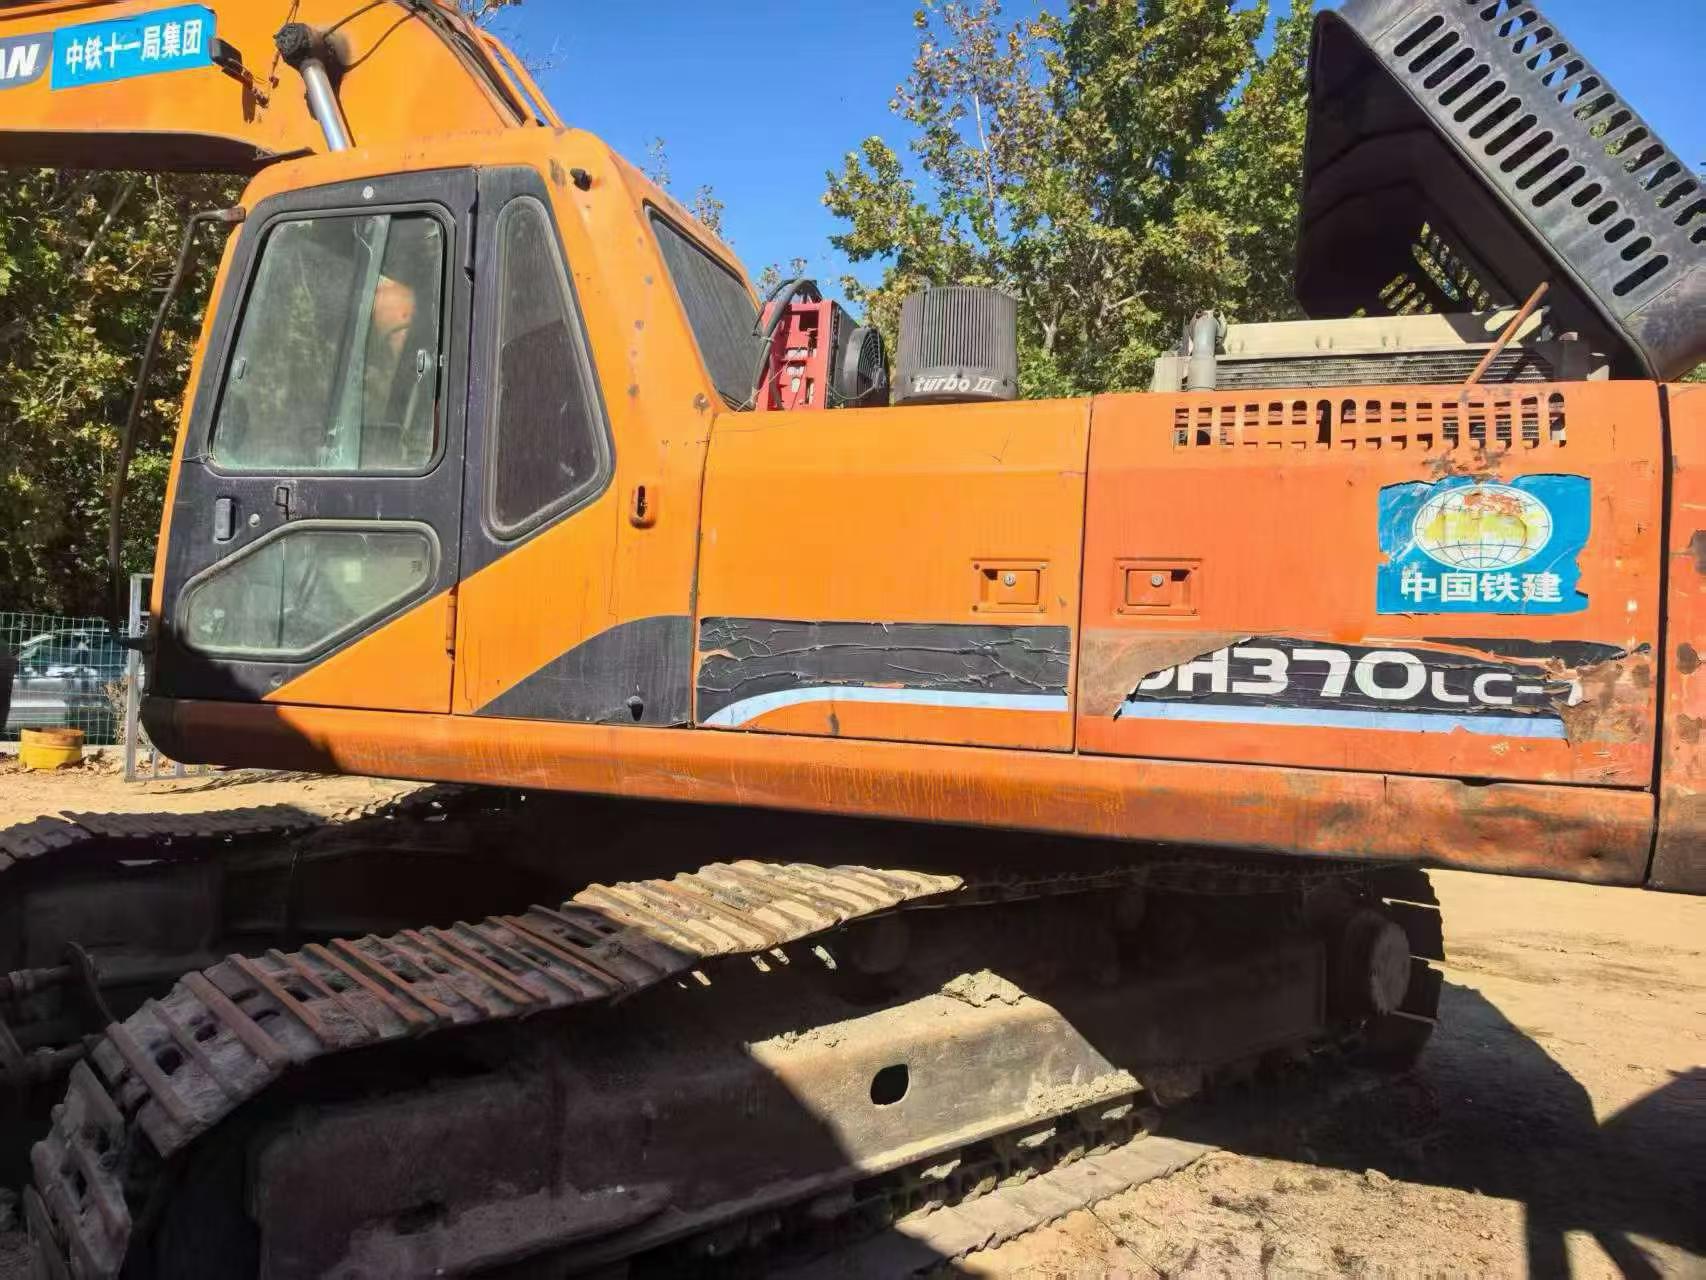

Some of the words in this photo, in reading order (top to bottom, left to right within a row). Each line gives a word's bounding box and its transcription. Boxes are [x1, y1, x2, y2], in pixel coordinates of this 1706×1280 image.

[0, 43, 40, 79] N
[65, 18, 203, 75] 中铁十一局集团
[913, 374, 970, 393] turbo
[1400, 570, 1564, 603] 中国铁建
